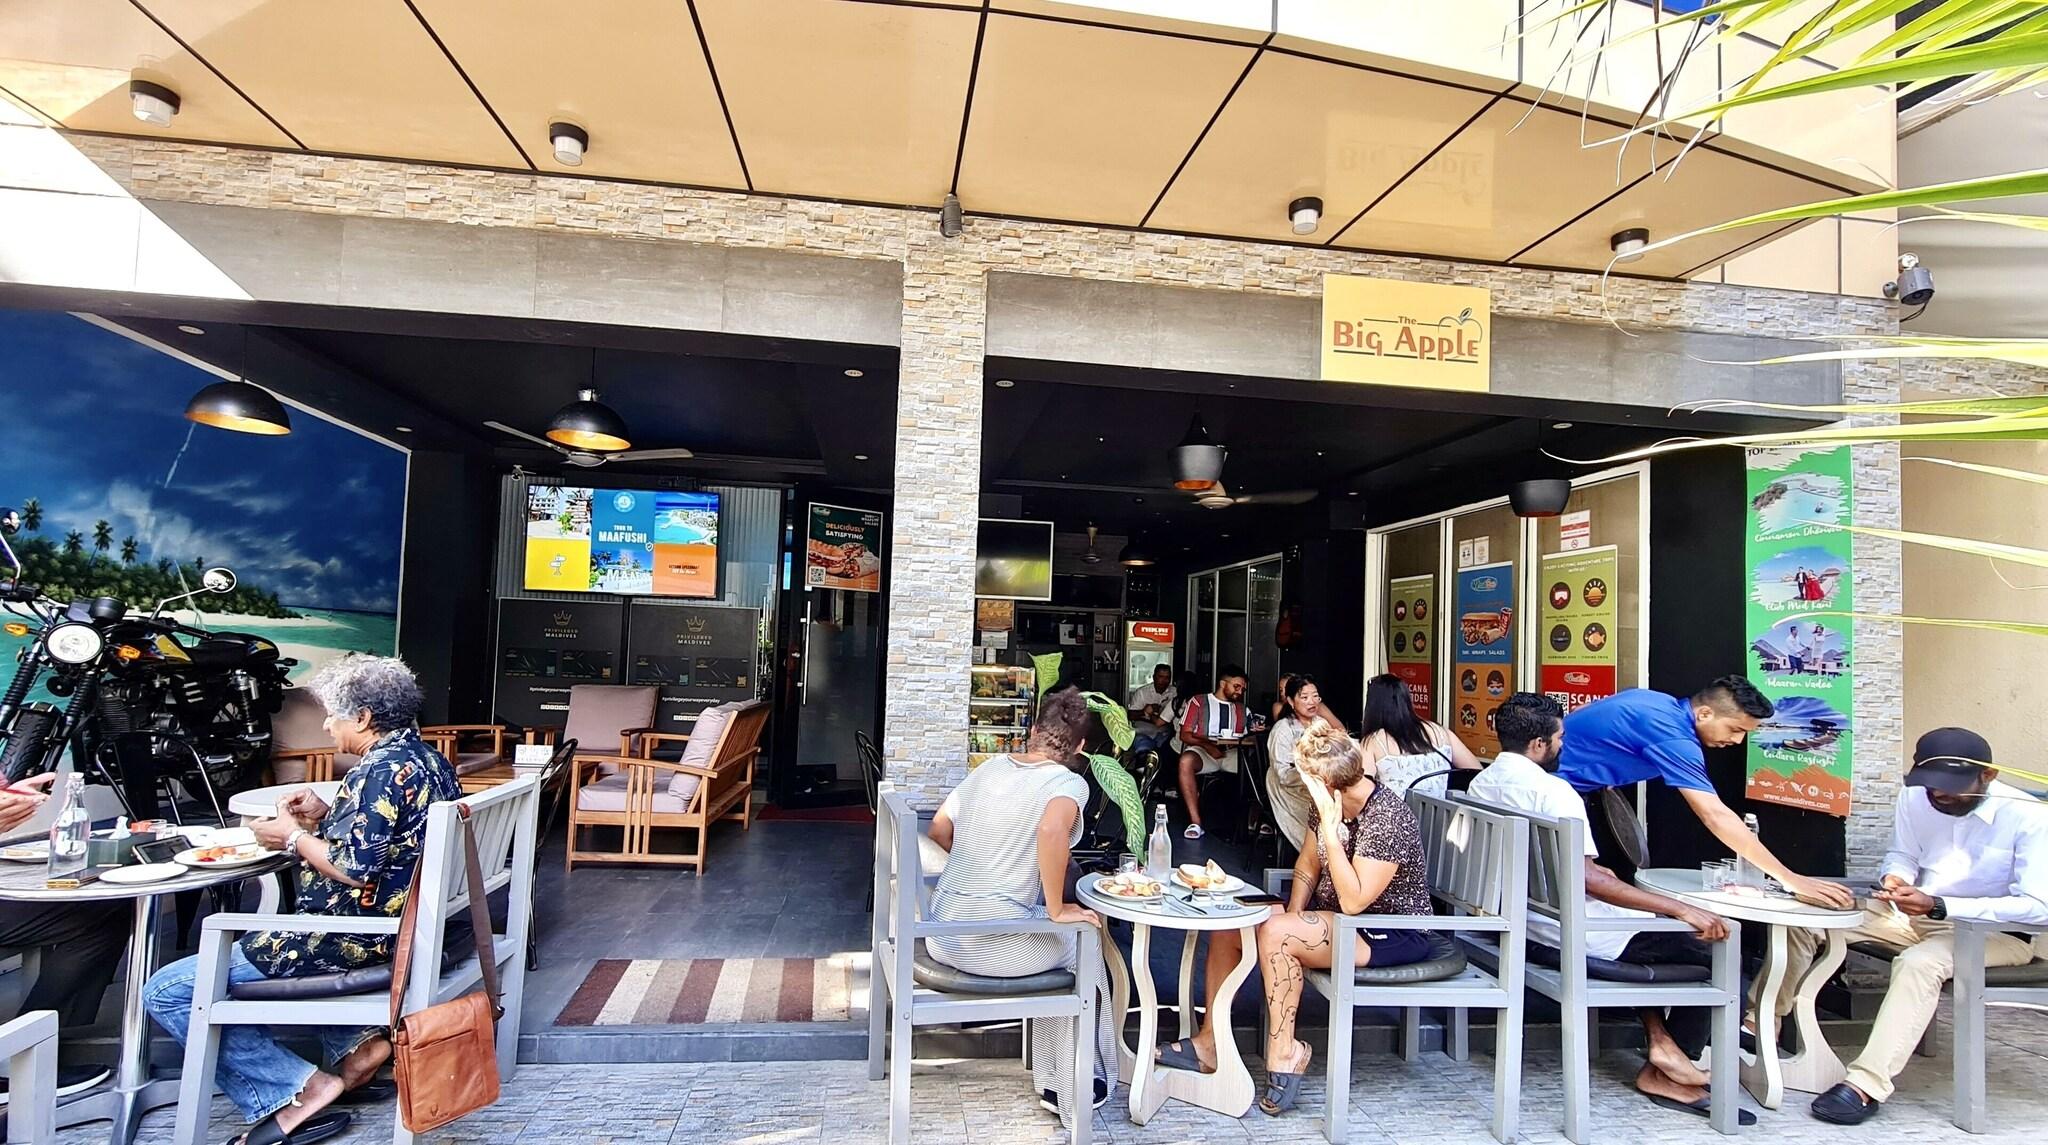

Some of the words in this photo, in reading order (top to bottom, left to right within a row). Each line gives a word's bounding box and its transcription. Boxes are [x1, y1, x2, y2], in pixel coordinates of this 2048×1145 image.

[1398, 316, 1417, 326] The
[1333, 320, 1383, 356] Big
[1395, 326, 1479, 361] Apple
[825, 522, 865, 533] DELICIOUSLY
[598, 531, 647, 543] MAAFUSHI
[825, 530, 864, 540] SATISFYING
[1787, 600, 1808, 610] Med
